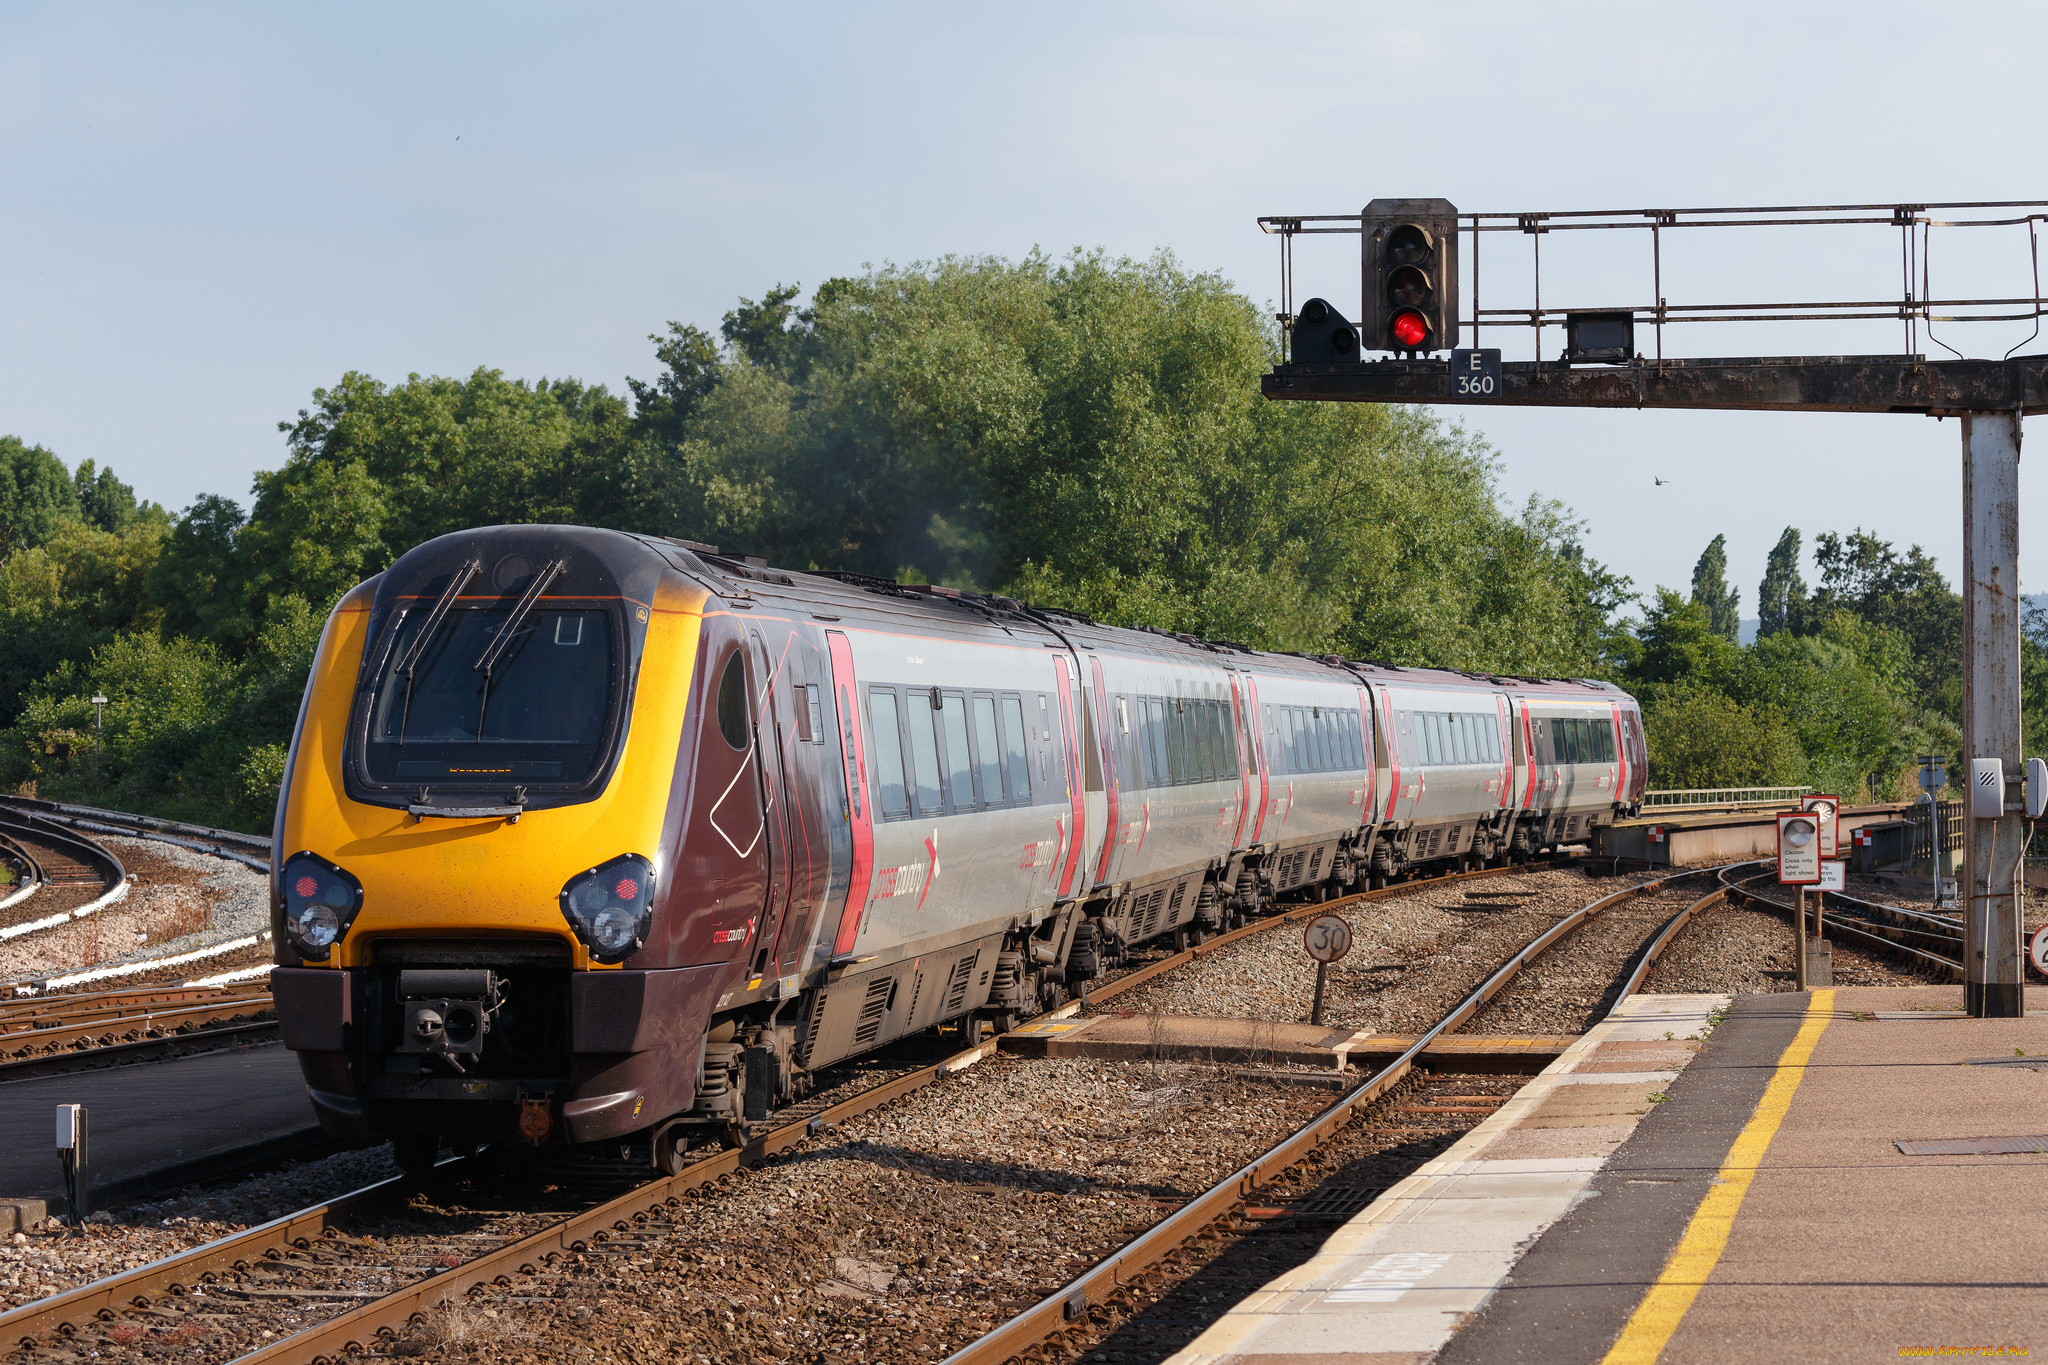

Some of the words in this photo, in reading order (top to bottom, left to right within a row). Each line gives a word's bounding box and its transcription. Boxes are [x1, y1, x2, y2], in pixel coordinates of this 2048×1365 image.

[1470, 353, 1482, 371] E
[1458, 375, 1495, 394] 360
[873, 857, 925, 901] crosscountry
[713, 926, 748, 943] crosscountry
[1313, 924, 1346, 953] 30
